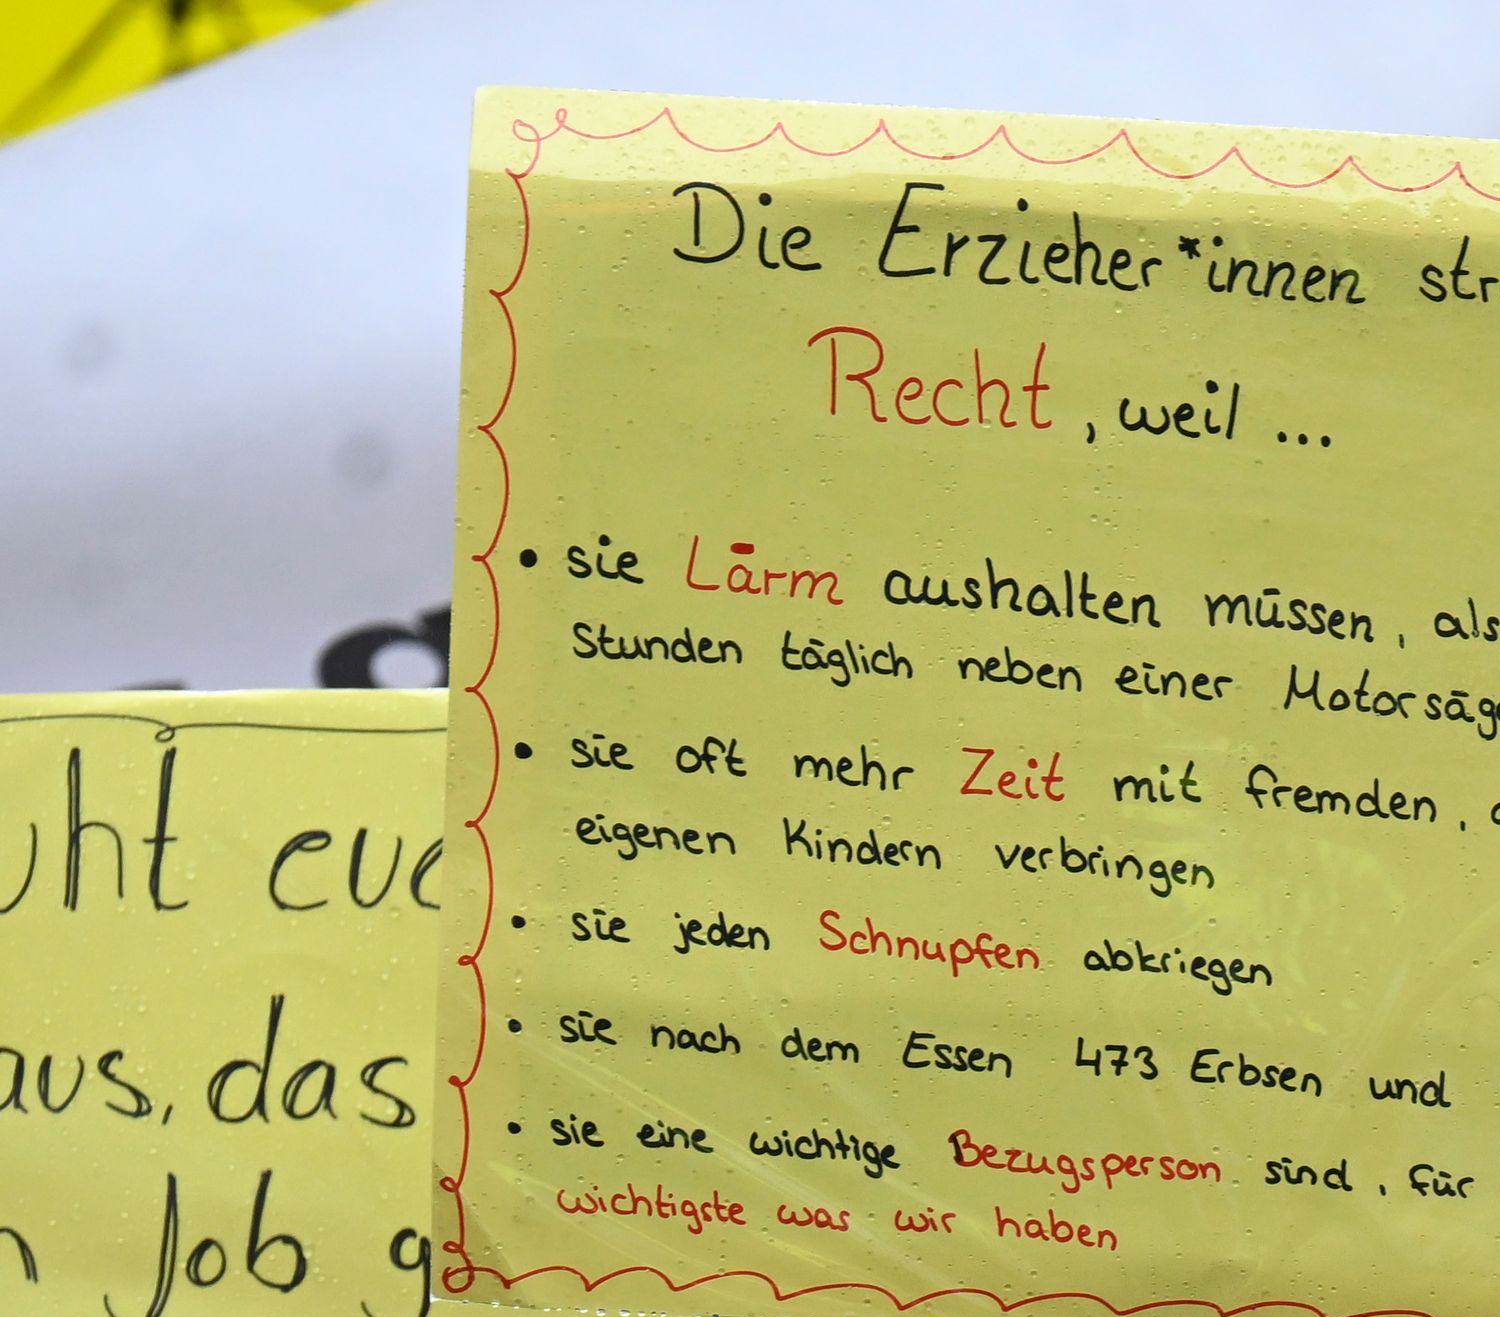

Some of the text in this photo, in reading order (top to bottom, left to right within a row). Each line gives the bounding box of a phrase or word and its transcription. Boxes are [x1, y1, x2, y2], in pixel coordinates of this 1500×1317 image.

[673, 182, 820, 270] Die
[567, 534, 644, 583] sie
[884, 559, 1161, 629] aushalten
[1433, 600, 1500, 643] als
[957, 643, 1082, 694] neben
[1115, 660, 1233, 700] einer
[570, 733, 634, 771] sie
[675, 738, 748, 778] oft
[793, 747, 915, 793] mehr
[959, 745, 1065, 801] Zeit
[1113, 761, 1202, 805] mit
[575, 814, 1215, 898] eigenen Kindern verbringen
[570, 908, 1273, 996] sie jeden Schnupfen abkriegen
[207, 995, 416, 1129] das
[559, 1012, 616, 1047] sie
[651, 1020, 742, 1057] nach
[781, 1026, 860, 1065] dem
[902, 1034, 1013, 1079] Essen
[1074, 1037, 1160, 1083] 473
[1190, 1050, 1324, 1098] Erbsen
[1368, 1070, 1451, 1109] und
[551, 1114, 605, 1149] sie
[636, 1121, 714, 1154] eine
[749, 1127, 902, 1176] wichtige
[947, 1129, 1223, 1202] Bezugsperson
[555, 1188, 1118, 1252] wichtigste was wir haben
